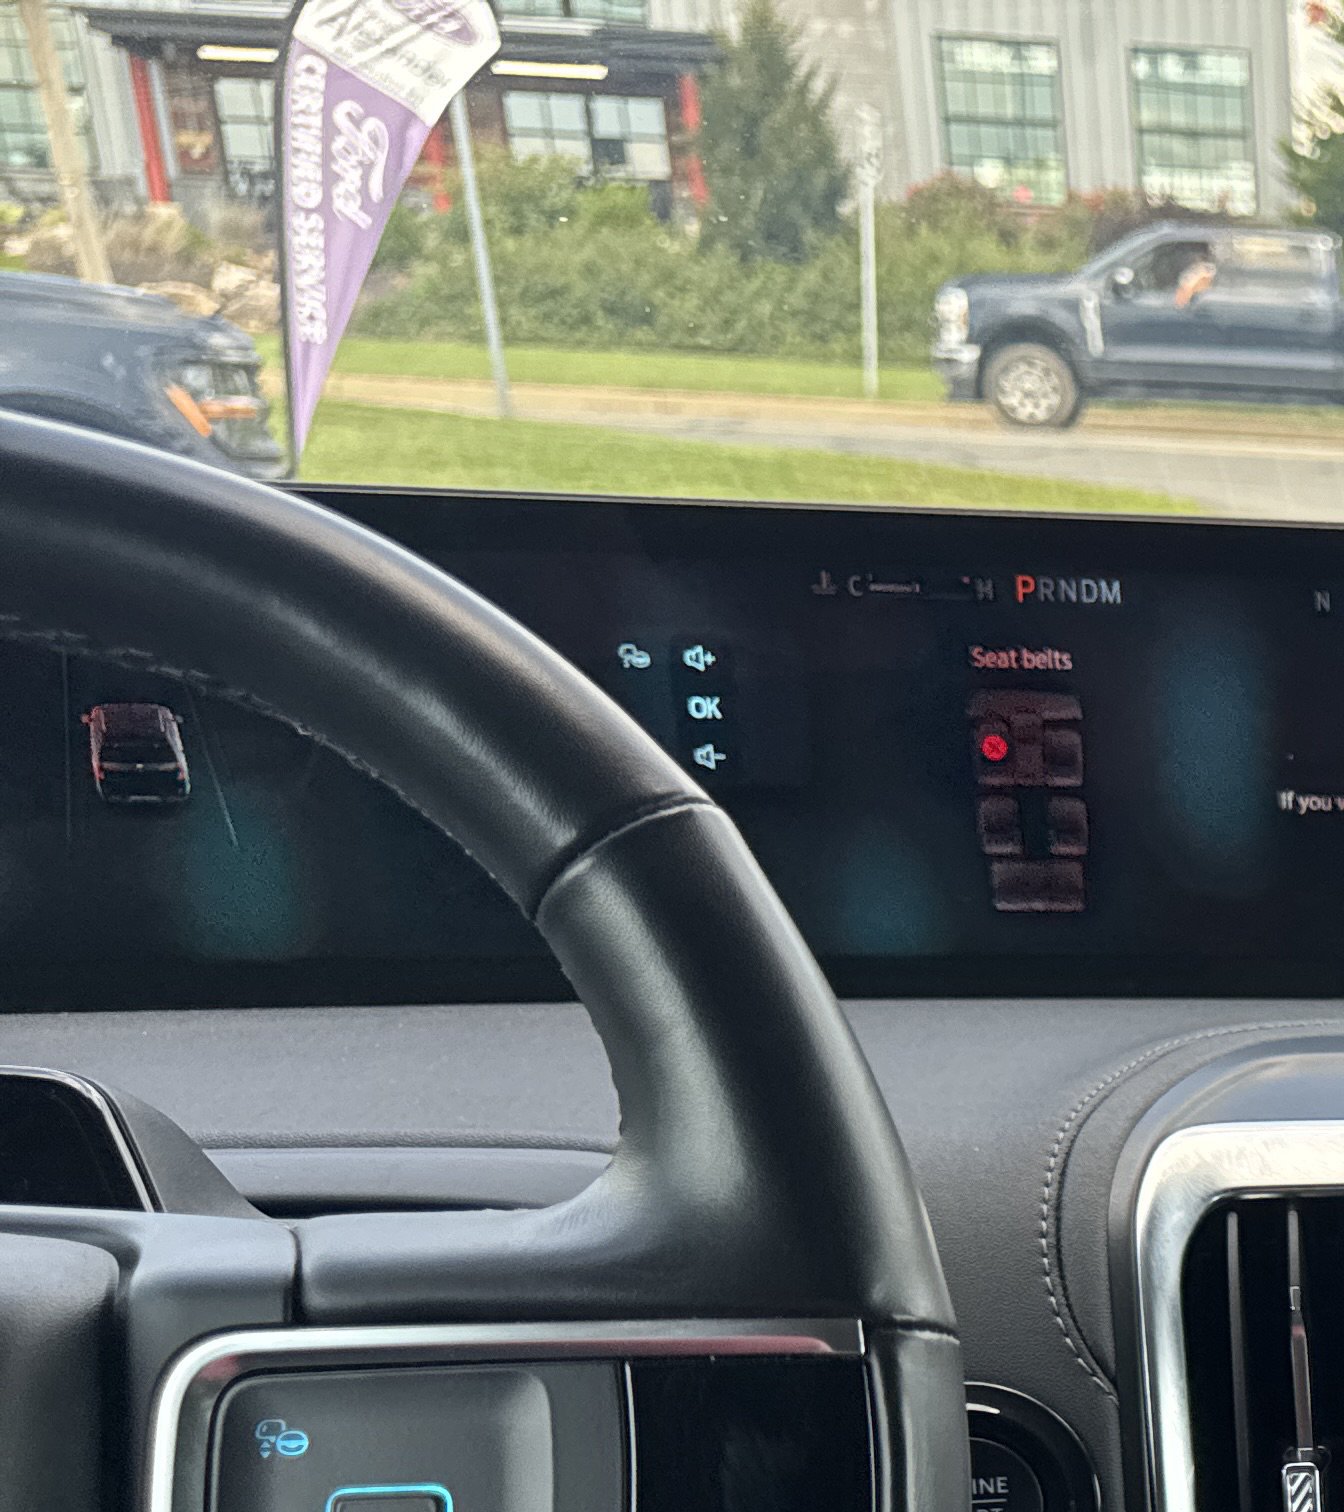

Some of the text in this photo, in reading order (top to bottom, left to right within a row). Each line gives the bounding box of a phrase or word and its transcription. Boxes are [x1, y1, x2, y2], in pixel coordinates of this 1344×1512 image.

[330, 100, 389, 229] Ford
[293, 211, 328, 345] SERVICE
[970, 645, 1073, 671] Seat belts
[686, 695, 724, 721] OK
[1280, 790, 1296, 811] If
[1297, 796, 1333, 815] you
[971, 1476, 1009, 1495] INE
